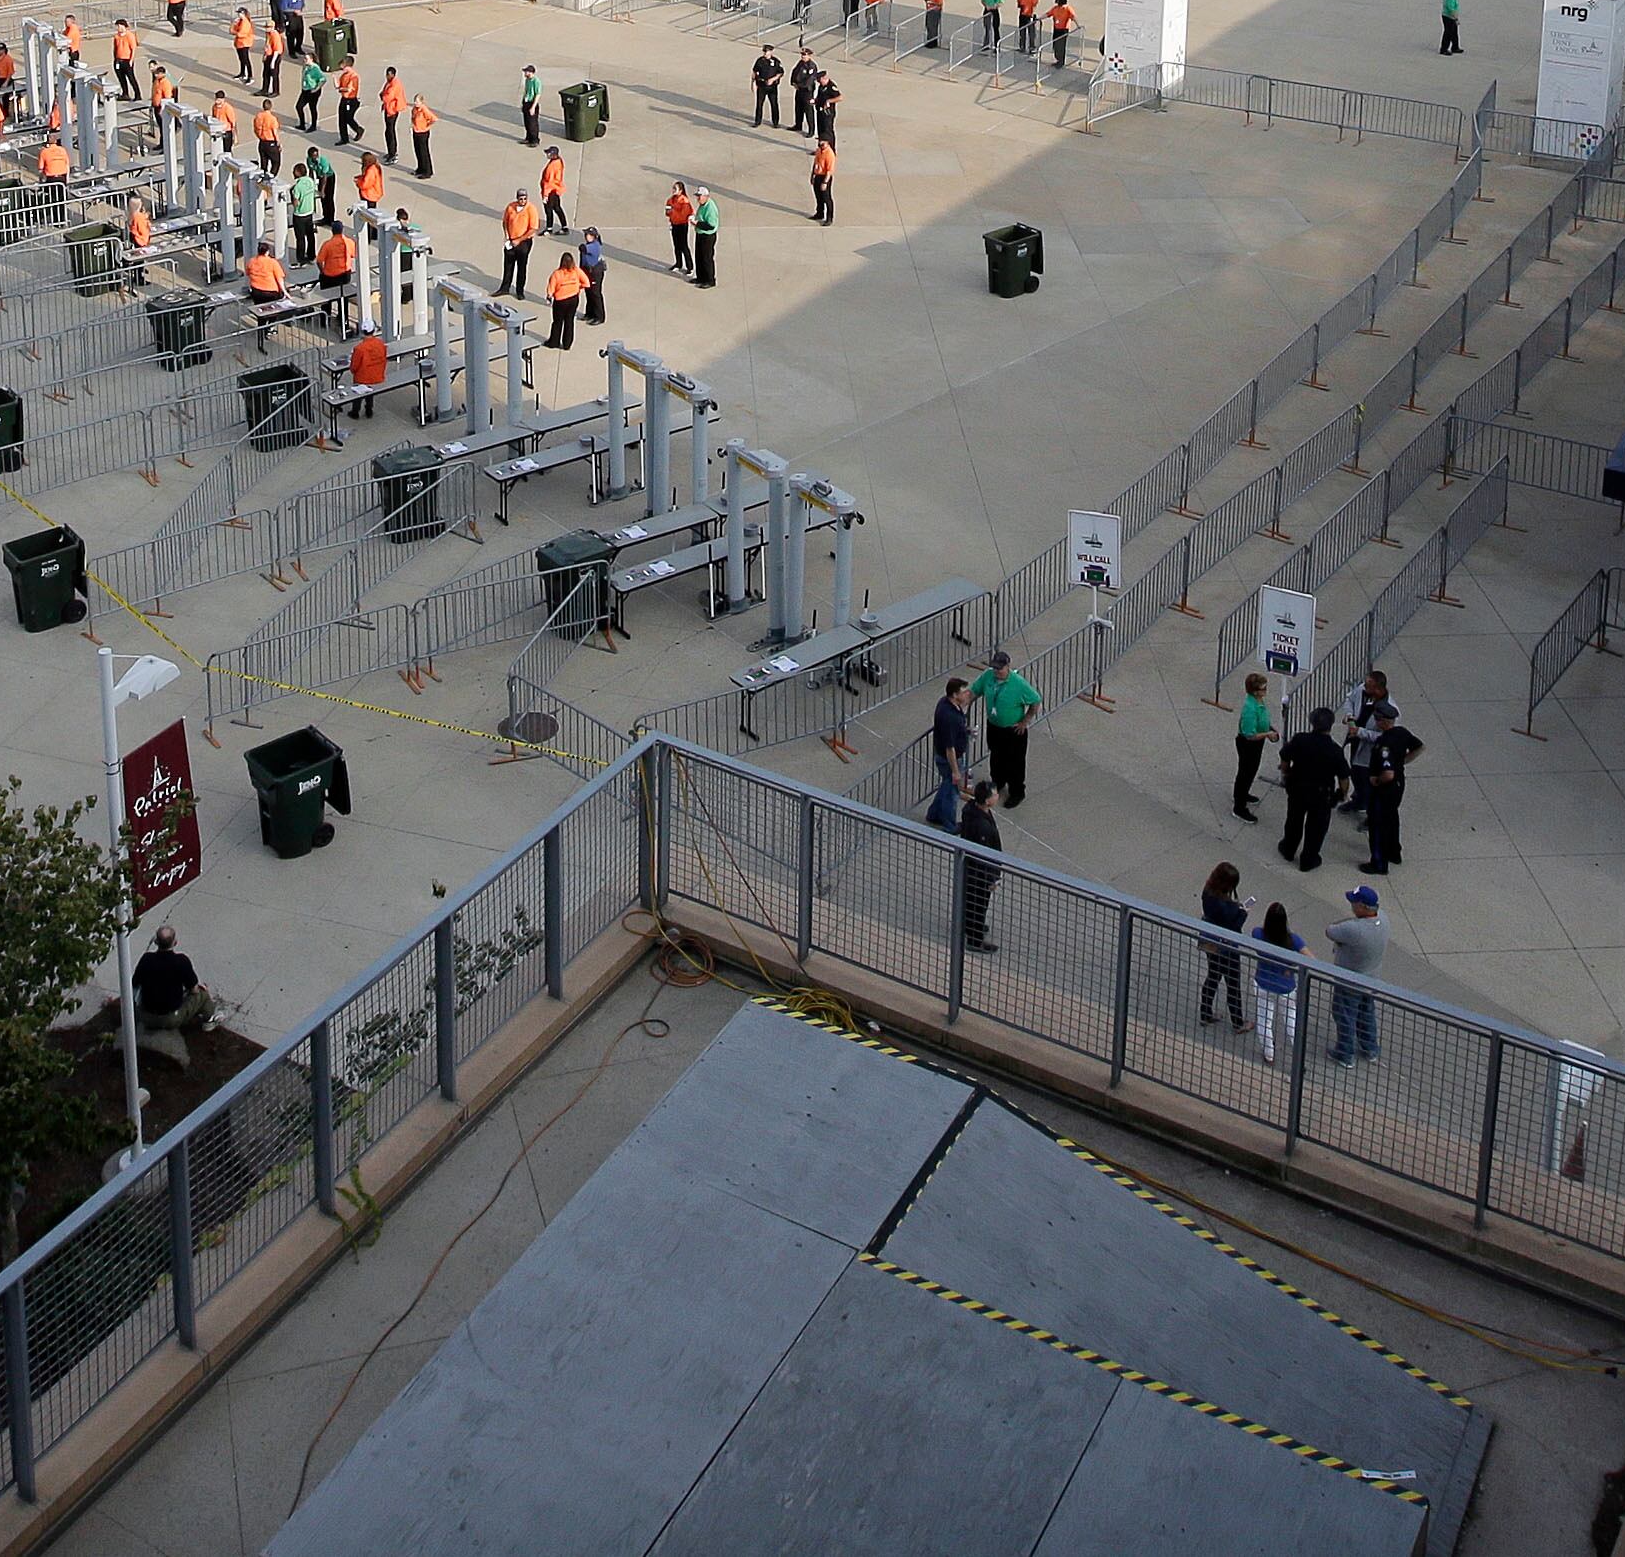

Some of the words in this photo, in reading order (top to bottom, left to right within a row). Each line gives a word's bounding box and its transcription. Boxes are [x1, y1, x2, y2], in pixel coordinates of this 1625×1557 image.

[1561, 5, 1588, 21] nrg
[1094, 555, 1111, 565] CALL
[1272, 632, 1300, 646] TICKET
[1272, 642, 1298, 656] SALES
